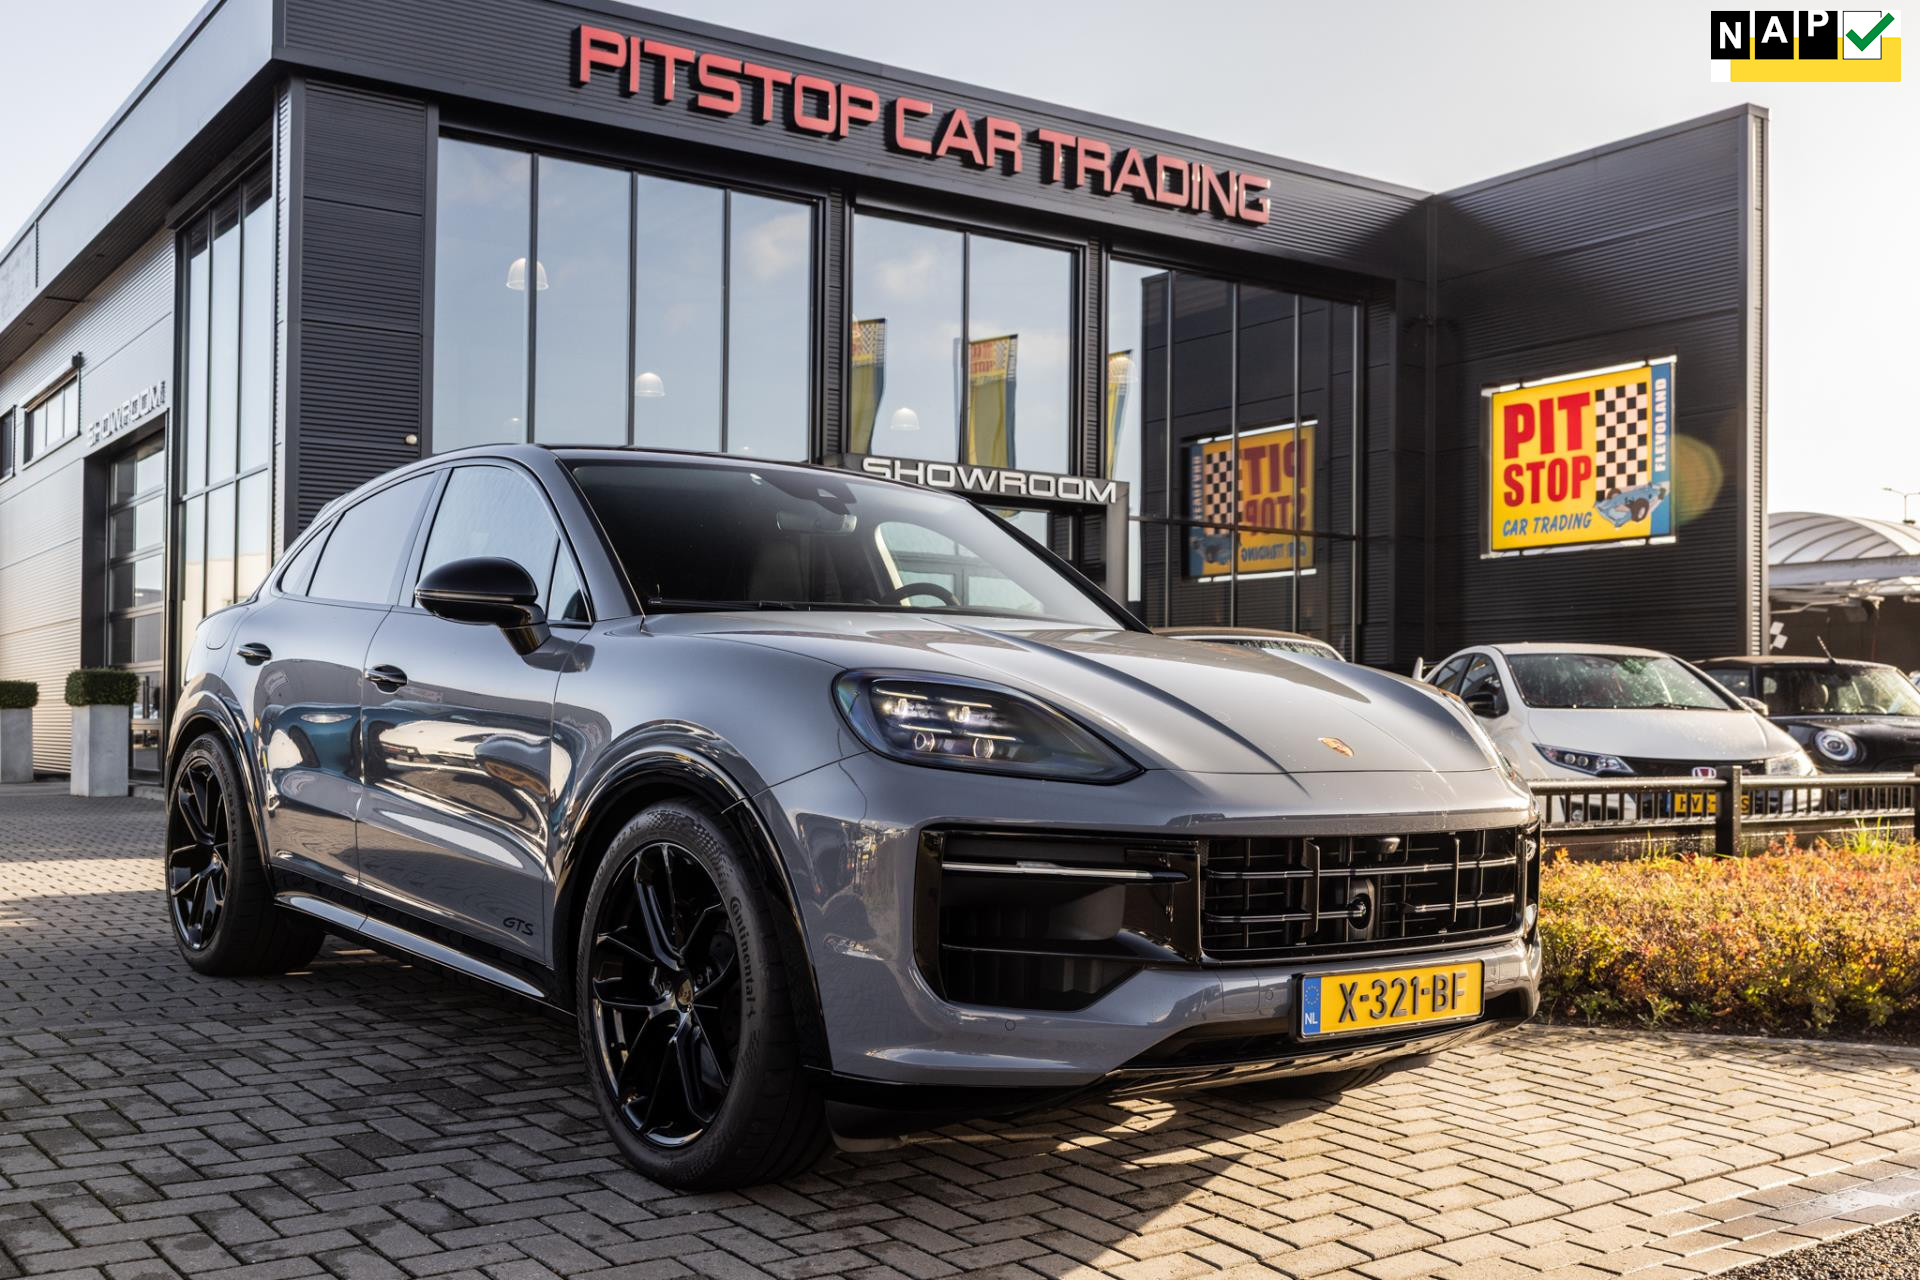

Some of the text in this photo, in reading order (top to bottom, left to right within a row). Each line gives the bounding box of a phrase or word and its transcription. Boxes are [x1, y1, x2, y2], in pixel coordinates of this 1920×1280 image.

[577, 24, 1271, 226] PITSTOP CAR TRADING
[1503, 391, 1591, 460] PIT
[1654, 378, 1668, 472] FLEVOLAND
[862, 456, 1117, 504] SHOWROOM
[1503, 455, 1592, 507] STOP
[1502, 511, 1592, 537] CAR TRADING
[503, 917, 534, 936] GTS
[730, 896, 756, 1003] Continental
[1304, 1012, 1318, 1025] NL
[1338, 971, 1467, 1024] X-321-BF
